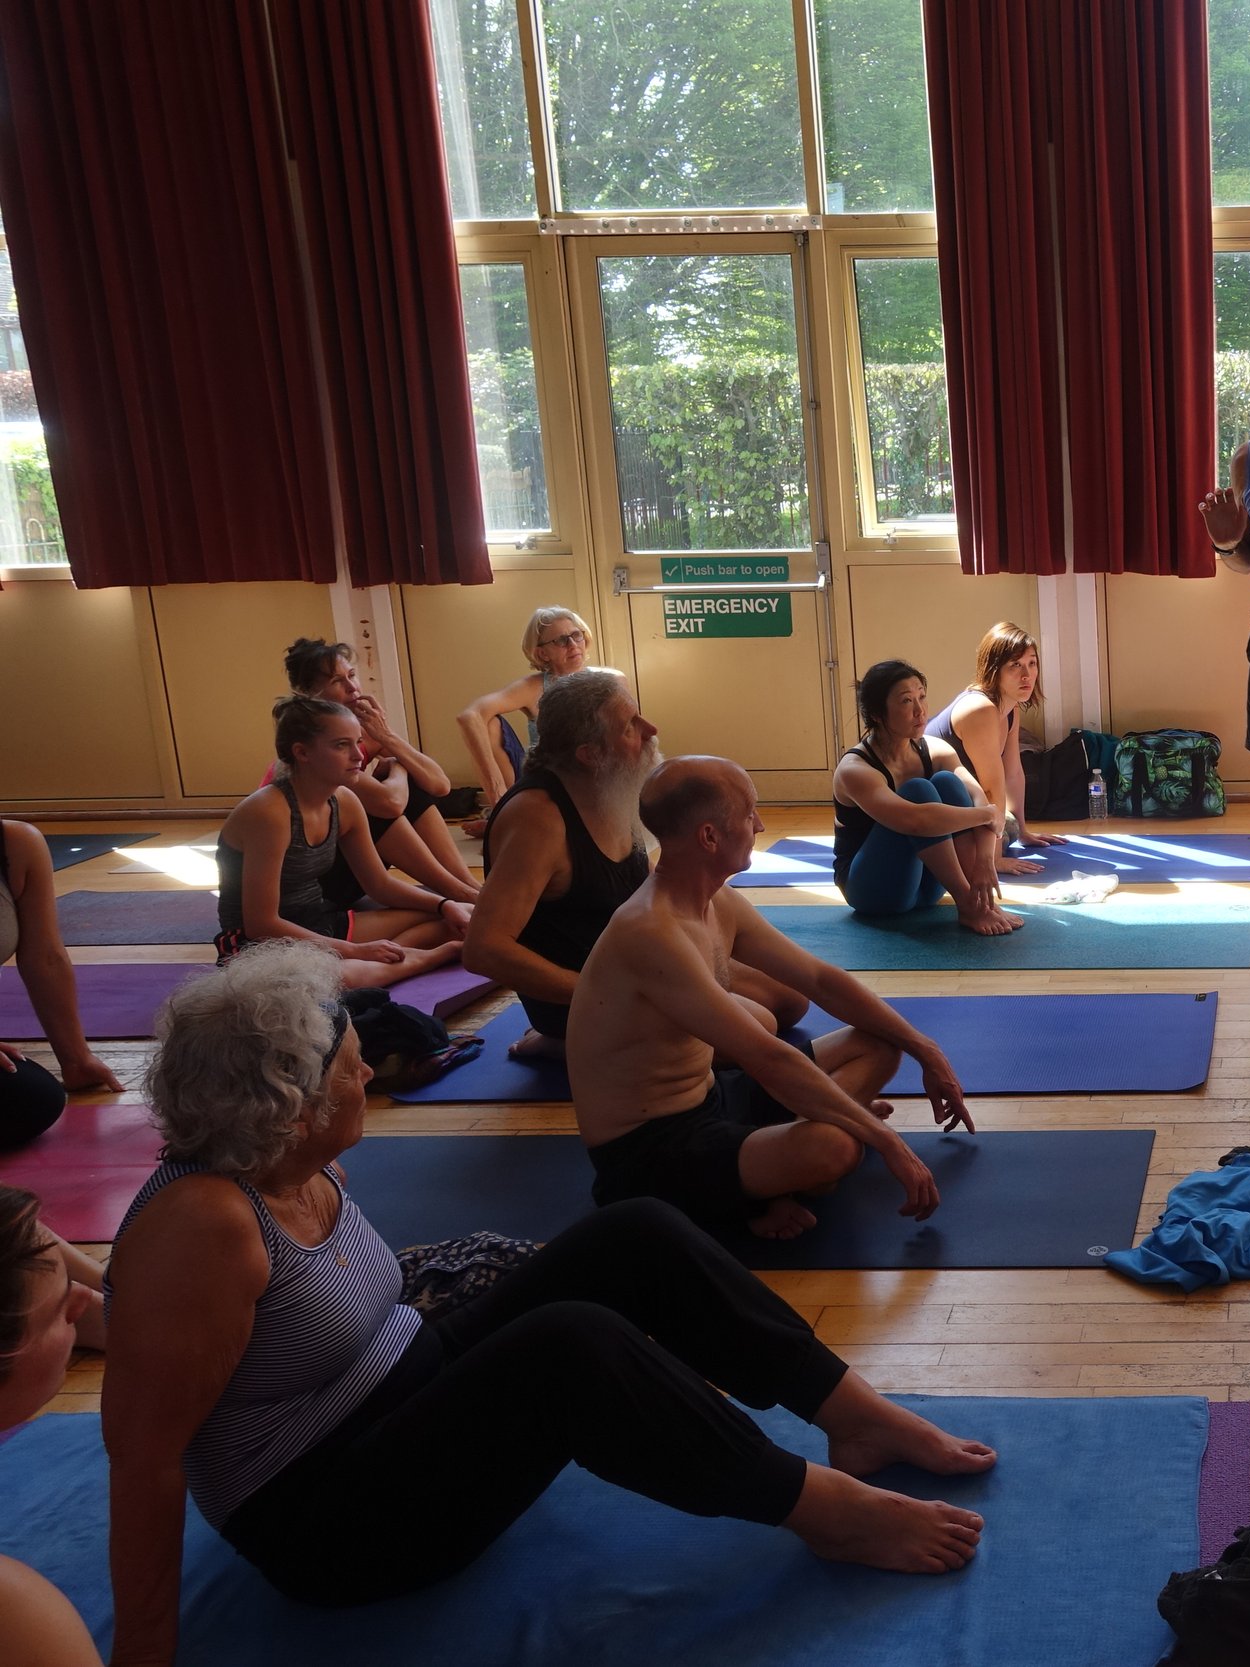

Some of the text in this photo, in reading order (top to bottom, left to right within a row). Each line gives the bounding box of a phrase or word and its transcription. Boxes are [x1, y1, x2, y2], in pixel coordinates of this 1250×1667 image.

[685, 564, 785, 577] Push bar to open
[664, 598, 780, 615] EMERGENCY
[665, 618, 706, 634] EXIT
